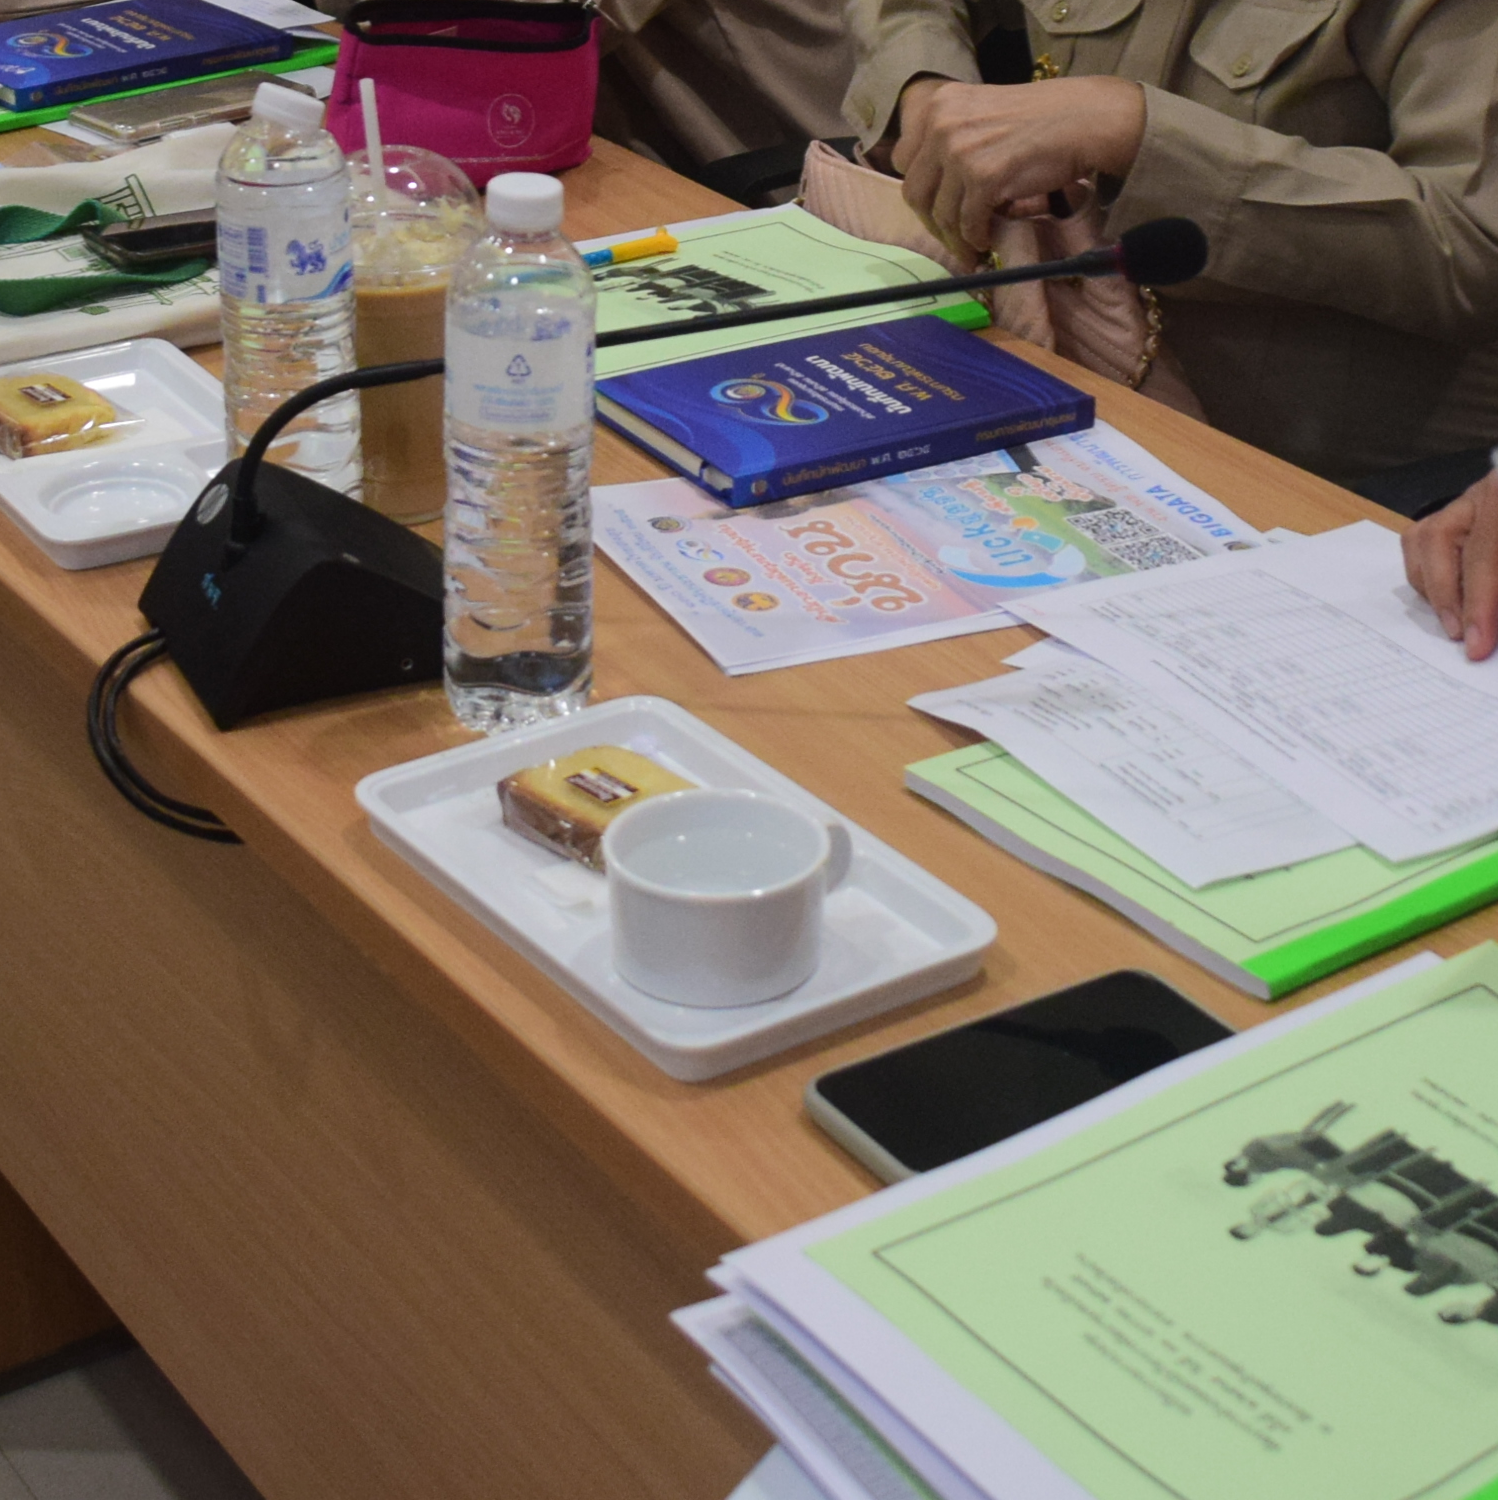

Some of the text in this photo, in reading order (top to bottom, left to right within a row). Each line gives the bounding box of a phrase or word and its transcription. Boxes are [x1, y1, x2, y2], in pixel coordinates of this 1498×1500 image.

[803, 354, 914, 415] บันทึกนักพัฒนา
[1141, 484, 1237, 537] BIGDATA
[781, 520, 927, 612] น่าน
